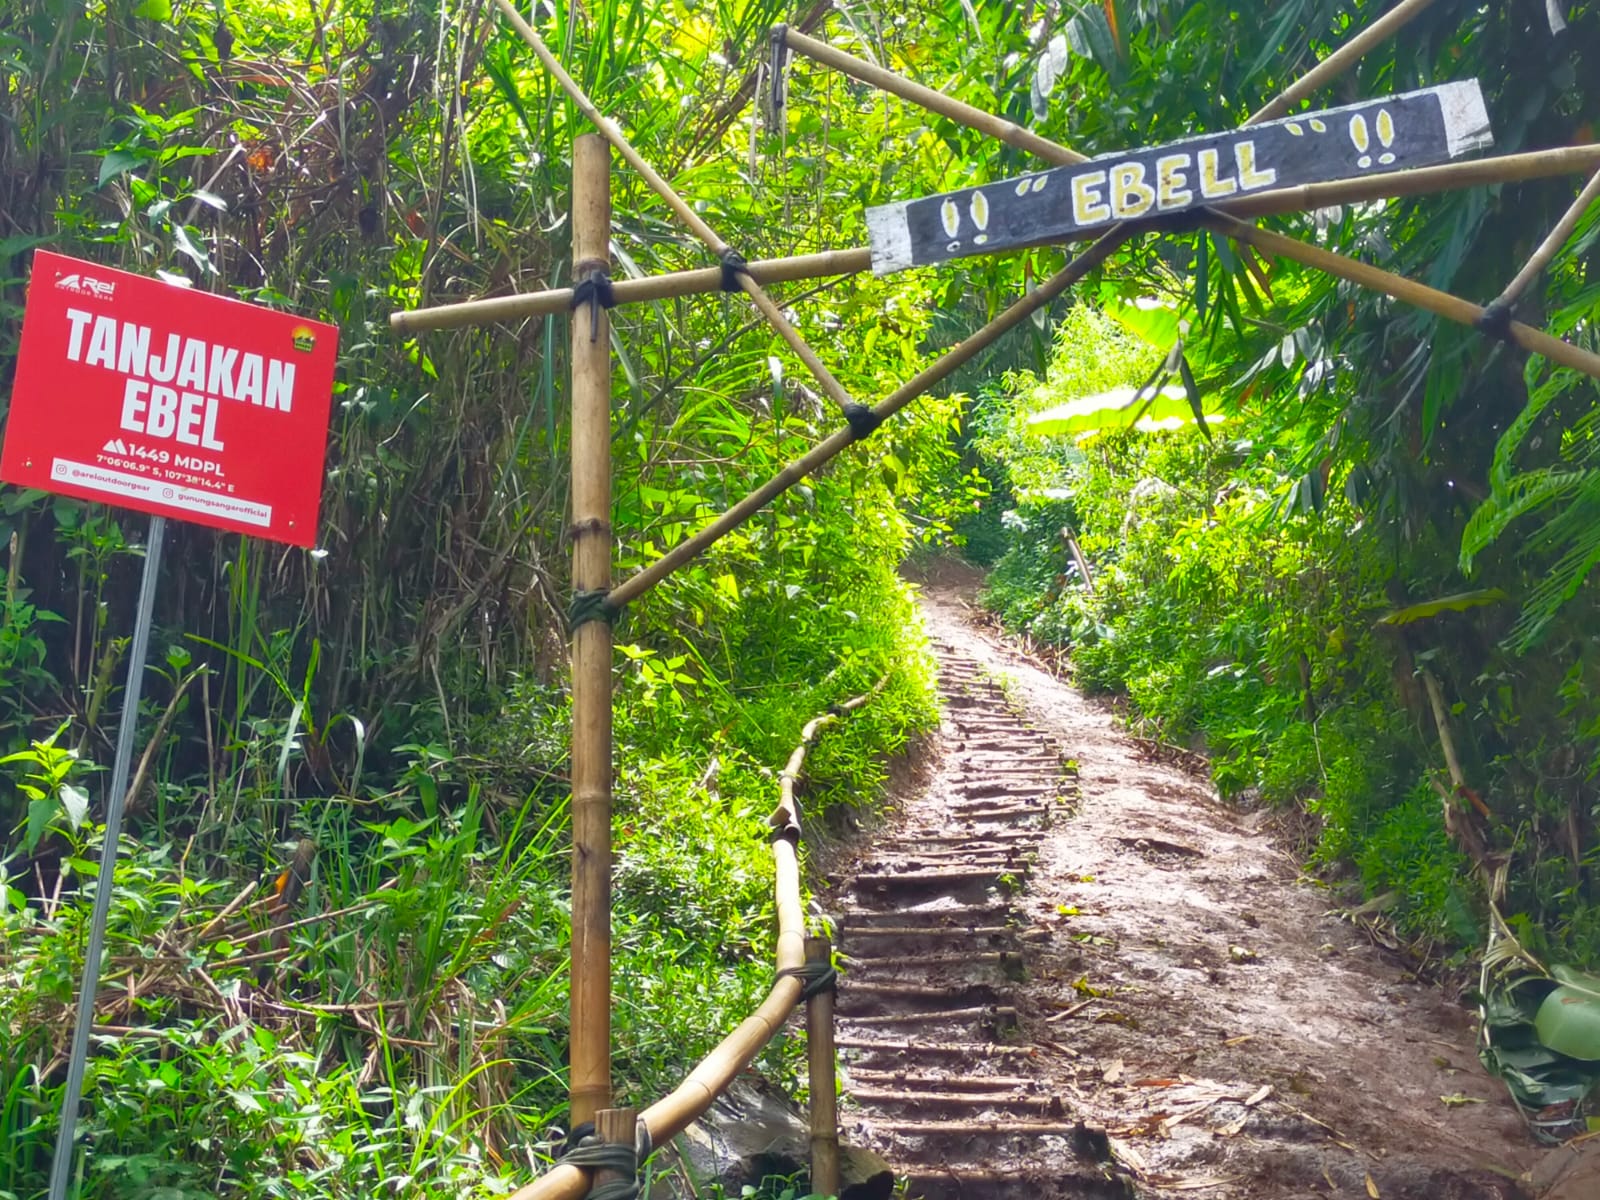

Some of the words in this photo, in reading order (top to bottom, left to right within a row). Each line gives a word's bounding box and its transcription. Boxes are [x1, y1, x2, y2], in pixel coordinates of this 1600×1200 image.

[1071, 140, 1276, 226] EBELL
[66, 308, 296, 413] TANJAKAN
[120, 378, 225, 452] EBEL
[128, 443, 170, 464] 1449
[174, 454, 225, 477] MDPL
[227, 484, 235, 493] E
